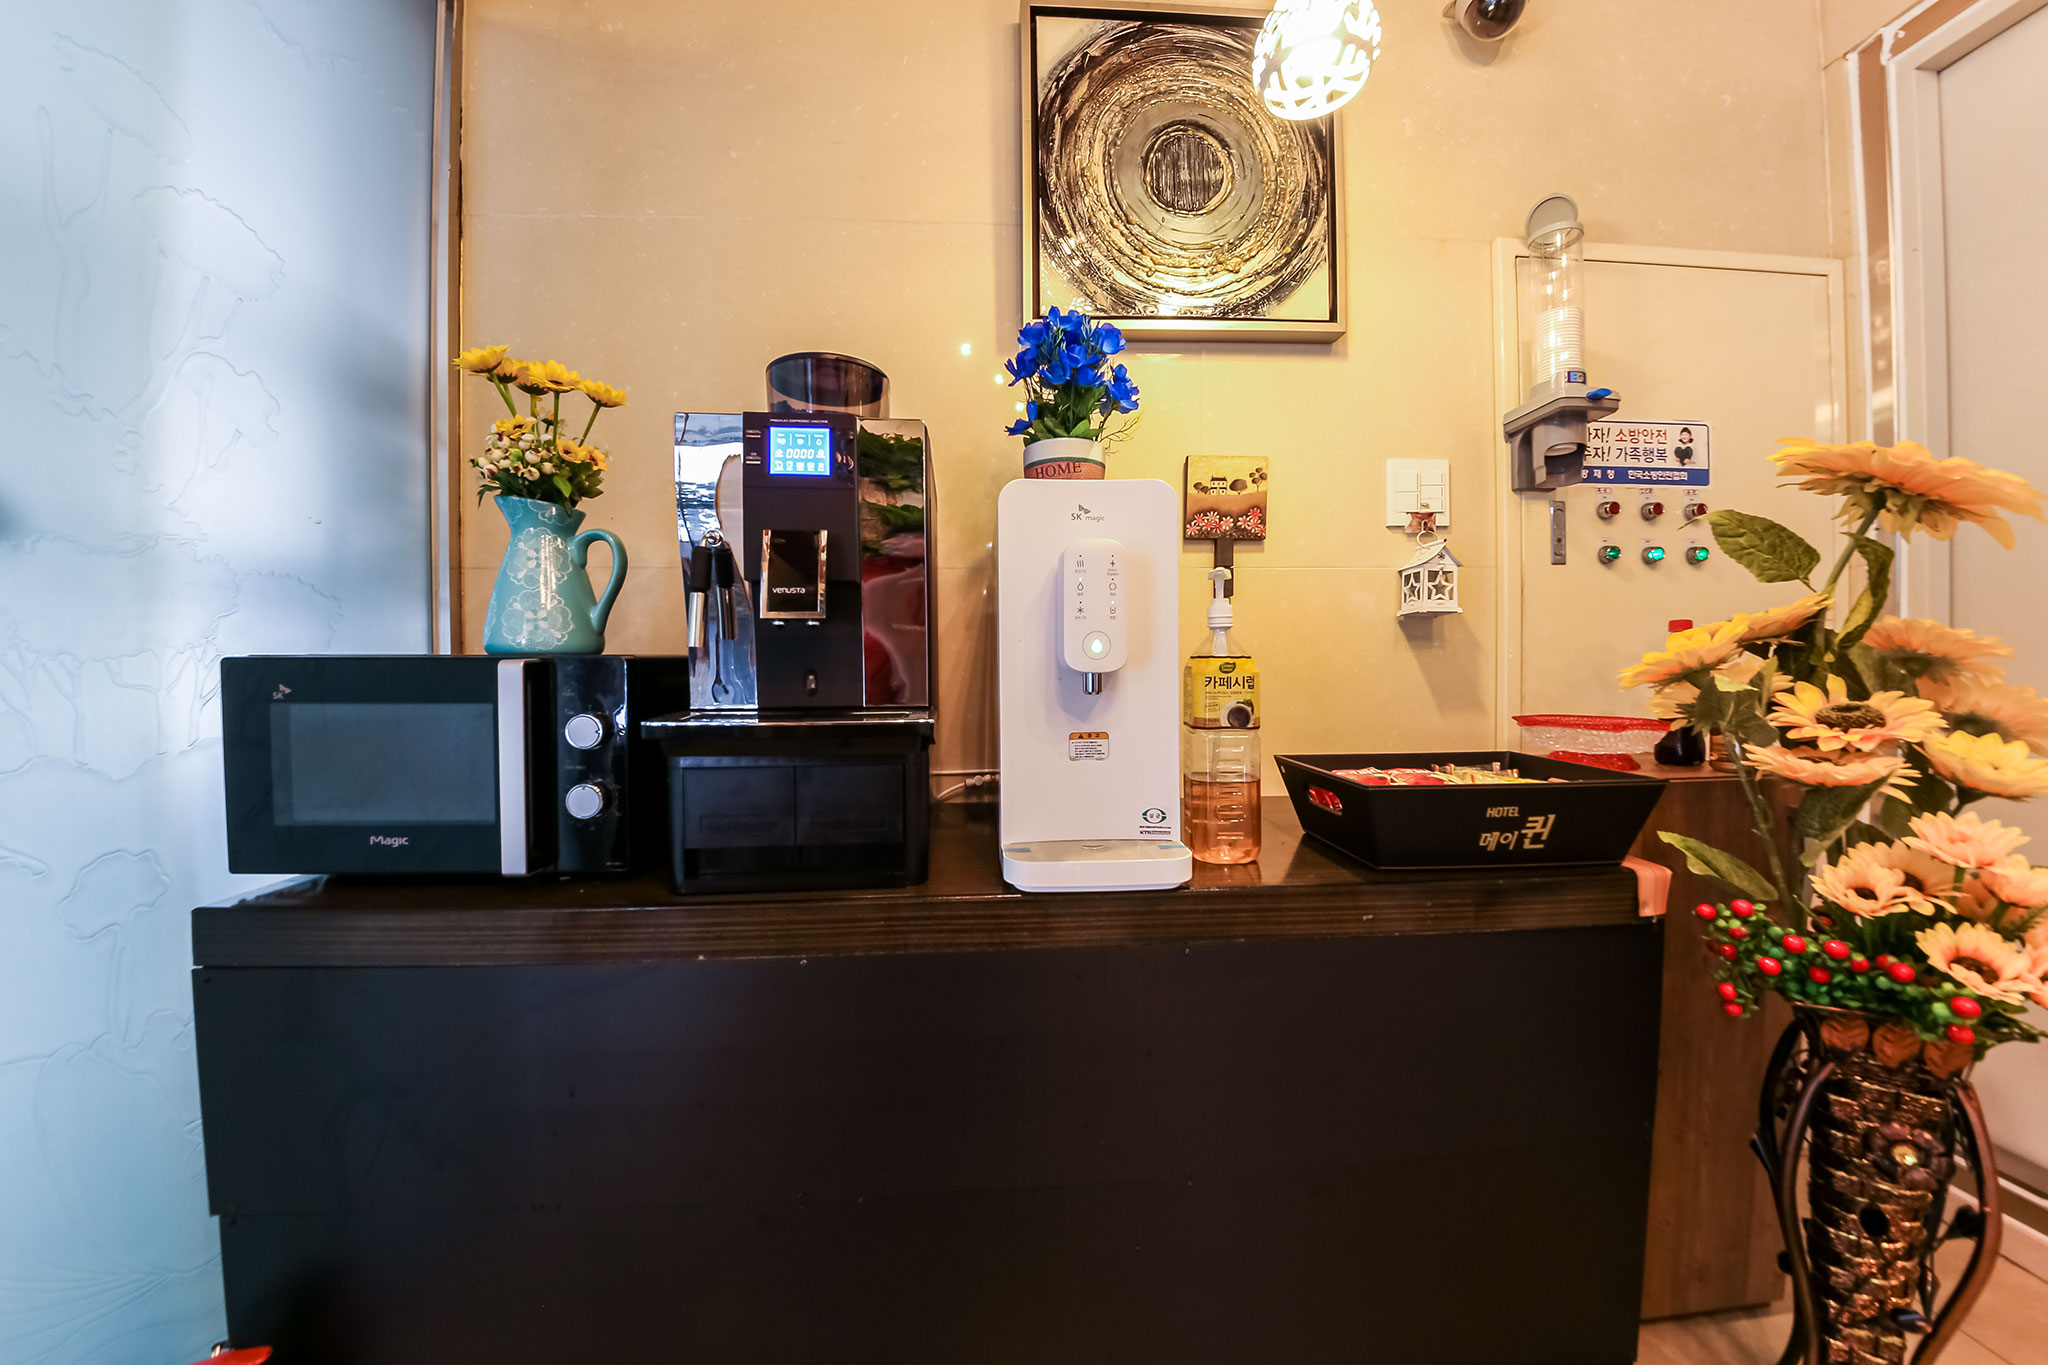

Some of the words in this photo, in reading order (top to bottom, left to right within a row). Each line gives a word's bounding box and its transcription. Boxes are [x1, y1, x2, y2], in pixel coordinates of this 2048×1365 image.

[1614, 428, 1668, 445] 소방안전
[785, 448, 815, 460] 0000
[1615, 447, 1668, 463] 가족행복
[1035, 461, 1083, 479] HOME
[1071, 512, 1082, 521] SK
[1085, 514, 1105, 523] magic
[1204, 675, 1255, 689] 카페시럽
[272, 691, 284, 700] SK
[1486, 806, 1519, 819] HOTEL
[1479, 814, 1555, 852] 메이퀸
[369, 834, 409, 848] Magic
